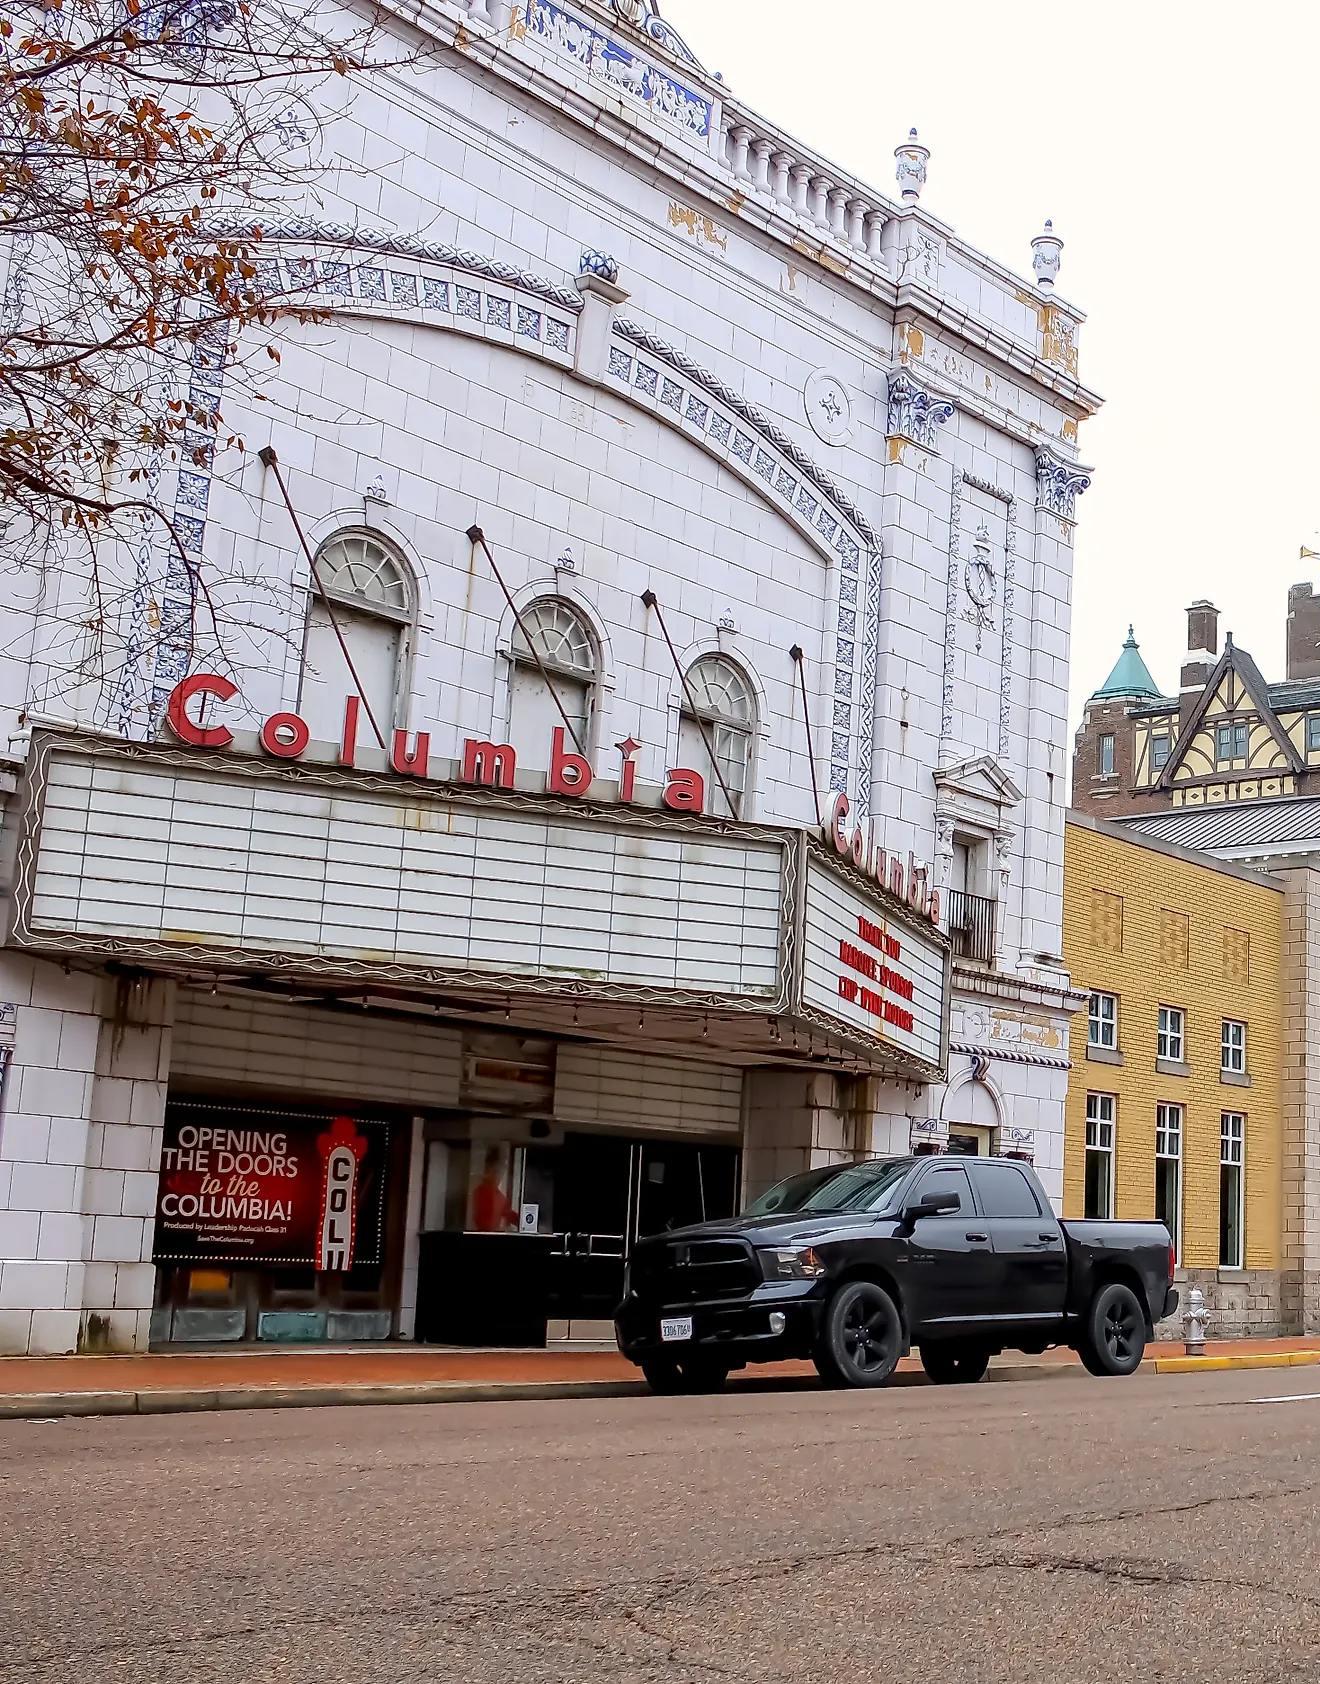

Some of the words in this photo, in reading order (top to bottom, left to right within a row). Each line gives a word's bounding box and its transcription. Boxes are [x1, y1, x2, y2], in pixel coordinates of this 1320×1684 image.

[167, 673, 704, 813] Columbia
[824, 792, 940, 925] Columbia
[178, 1125, 287, 1155] OPENING
[162, 1147, 209, 1172] THE
[217, 1152, 298, 1178] DOORS
[200, 1173, 223, 1194] to
[226, 1175, 260, 1196] the
[161, 1193, 292, 1221] COLUMBIA!
[195, 1223, 203, 1231] by
